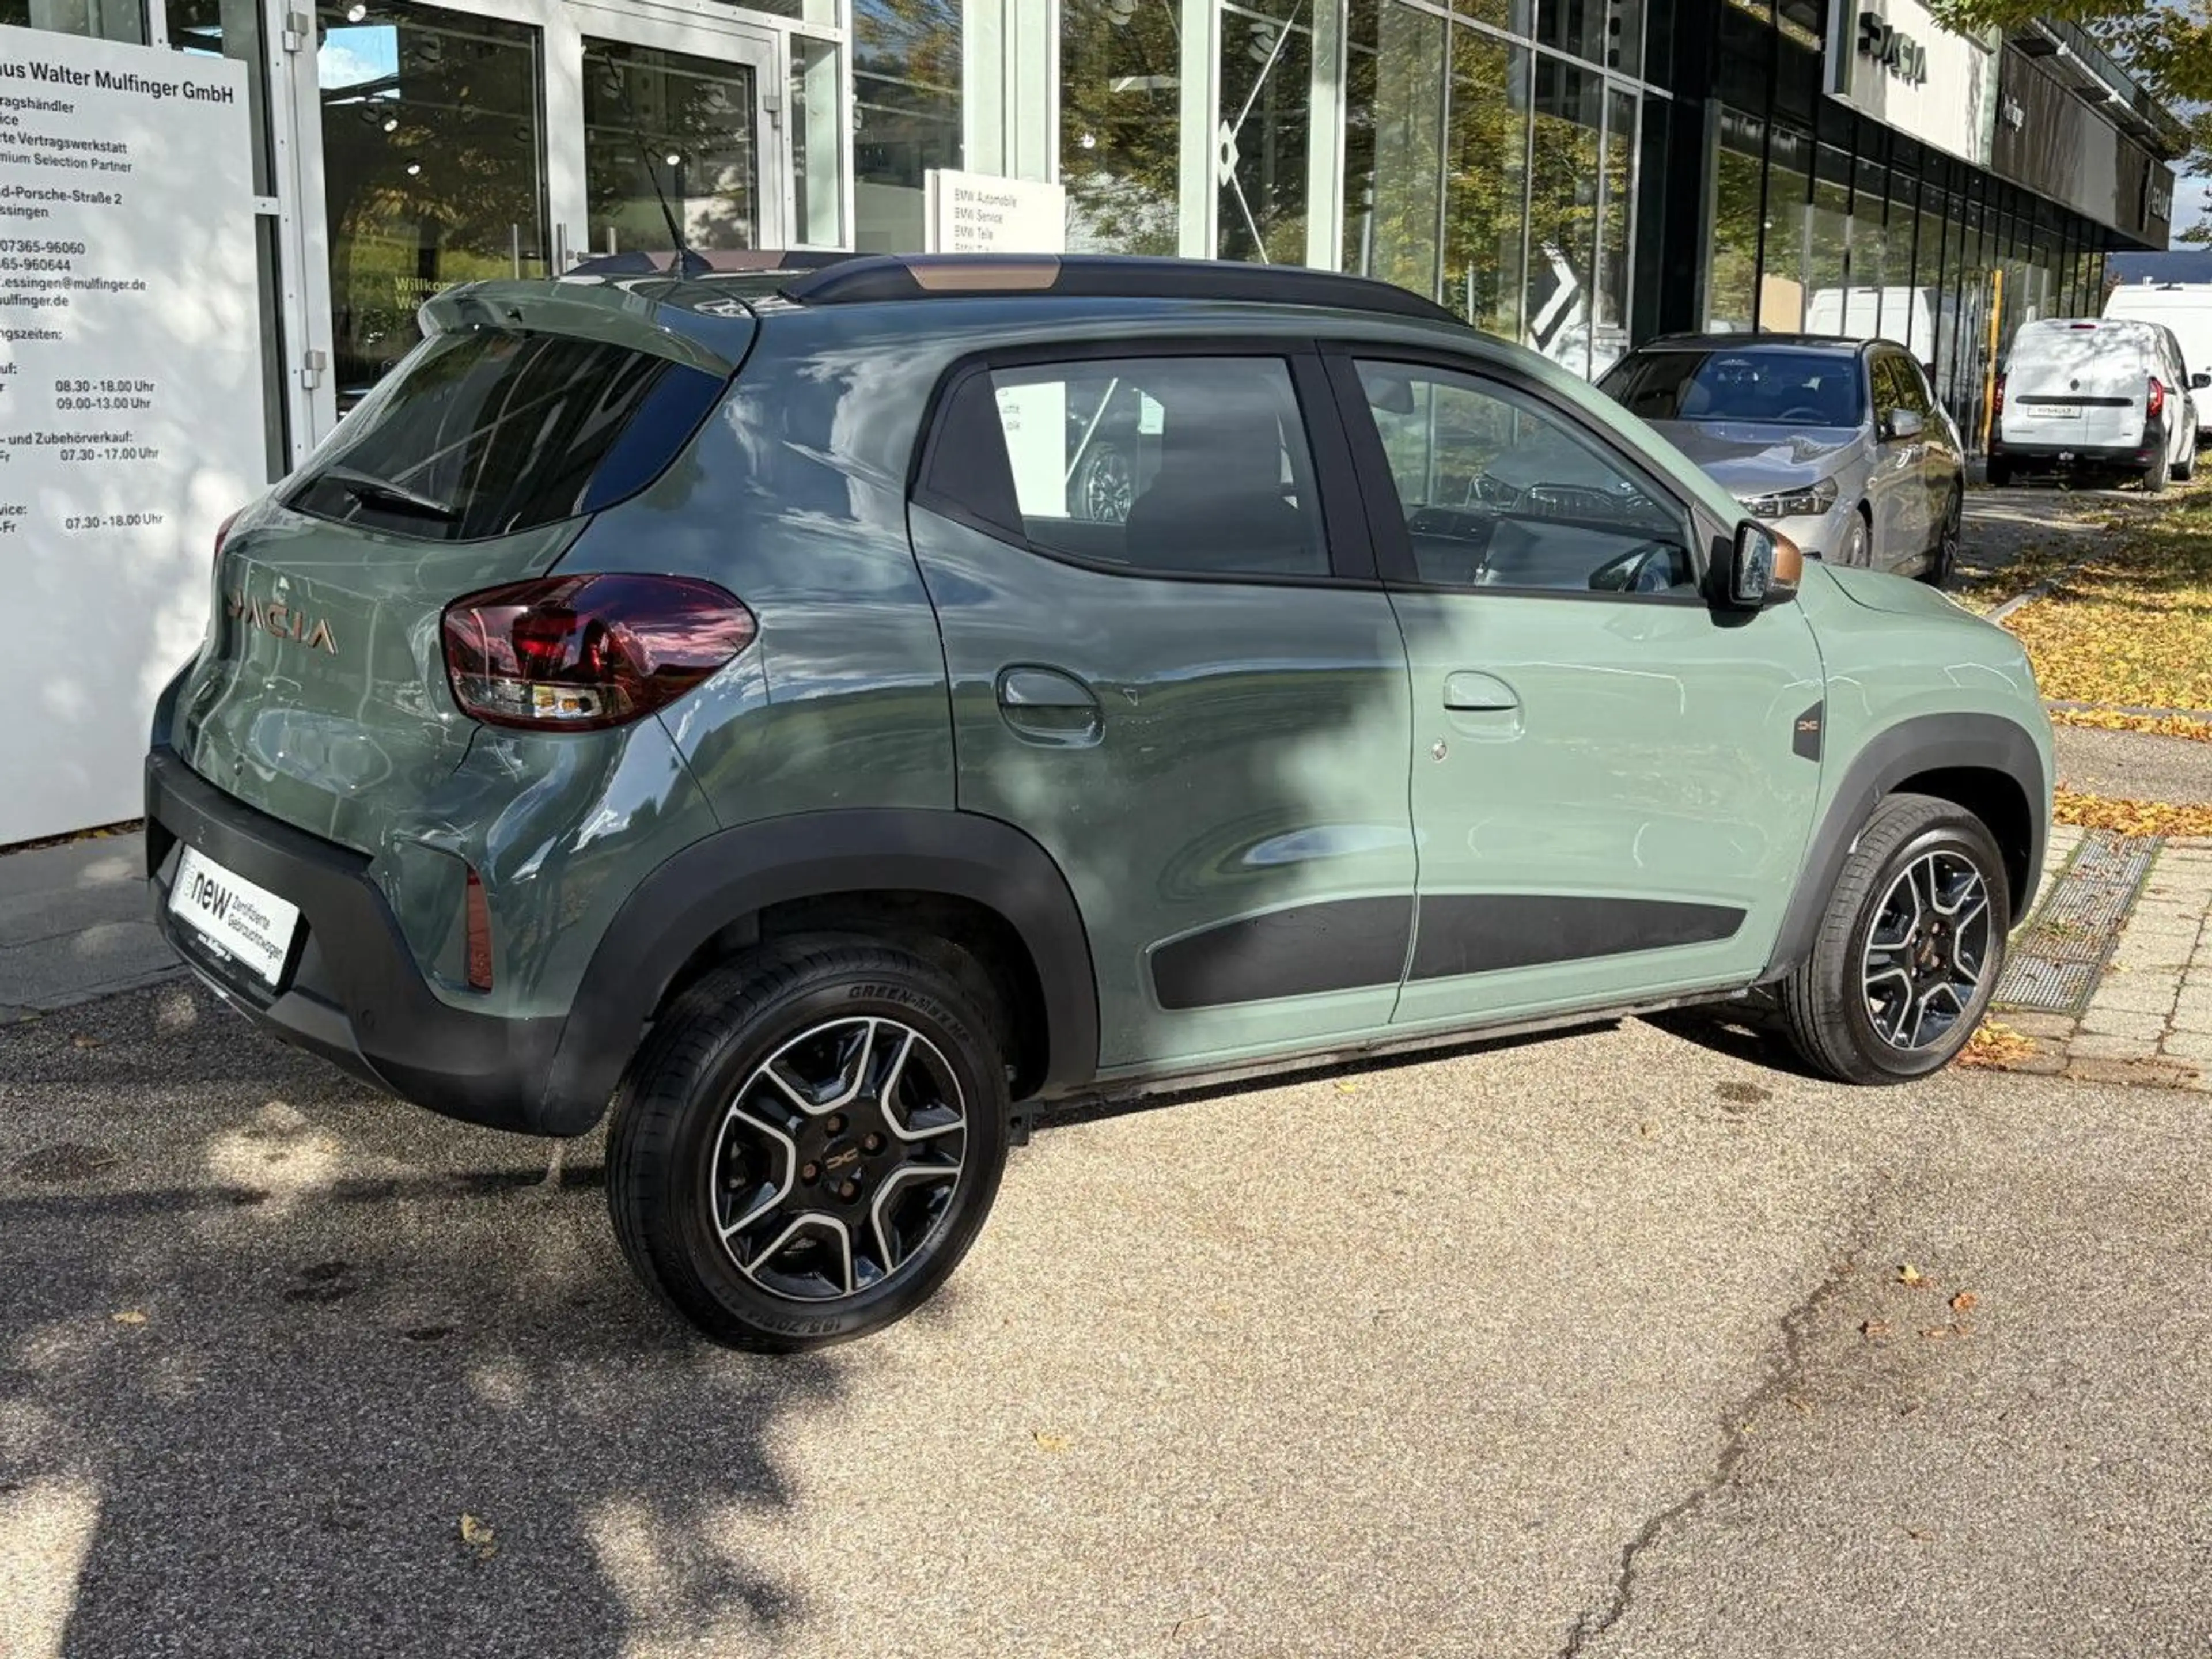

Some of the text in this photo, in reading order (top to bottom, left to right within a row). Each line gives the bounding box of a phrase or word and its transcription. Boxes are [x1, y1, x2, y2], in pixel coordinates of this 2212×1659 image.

[0, 62, 233, 103] us Walter Mulfinger GmbH
[17, 131, 127, 154] Vertragswerkstatt
[33, 153, 87, 169] Selection
[91, 158, 132, 173] Partner
[114, 194, 122, 204] 2
[1, 240, 85, 255] 07365-96060
[55, 380, 90, 392] 08.30
[100, 380, 132, 392] 18.00
[134, 380, 156, 392] Uhr
[56, 397, 151, 410] 09.00-13.00 Uhr
[9, 433, 32, 445] und
[35, 431, 133, 445] Zubehörverkauf:
[60, 449, 94, 461] 07.30
[104, 448, 137, 460] 17.00
[138, 448, 159, 459] Uhr
[66, 517, 100, 529] 07.30
[109, 514, 140, 527] 18.00
[143, 513, 164, 525] Uhr
[191, 872, 232, 920] new
